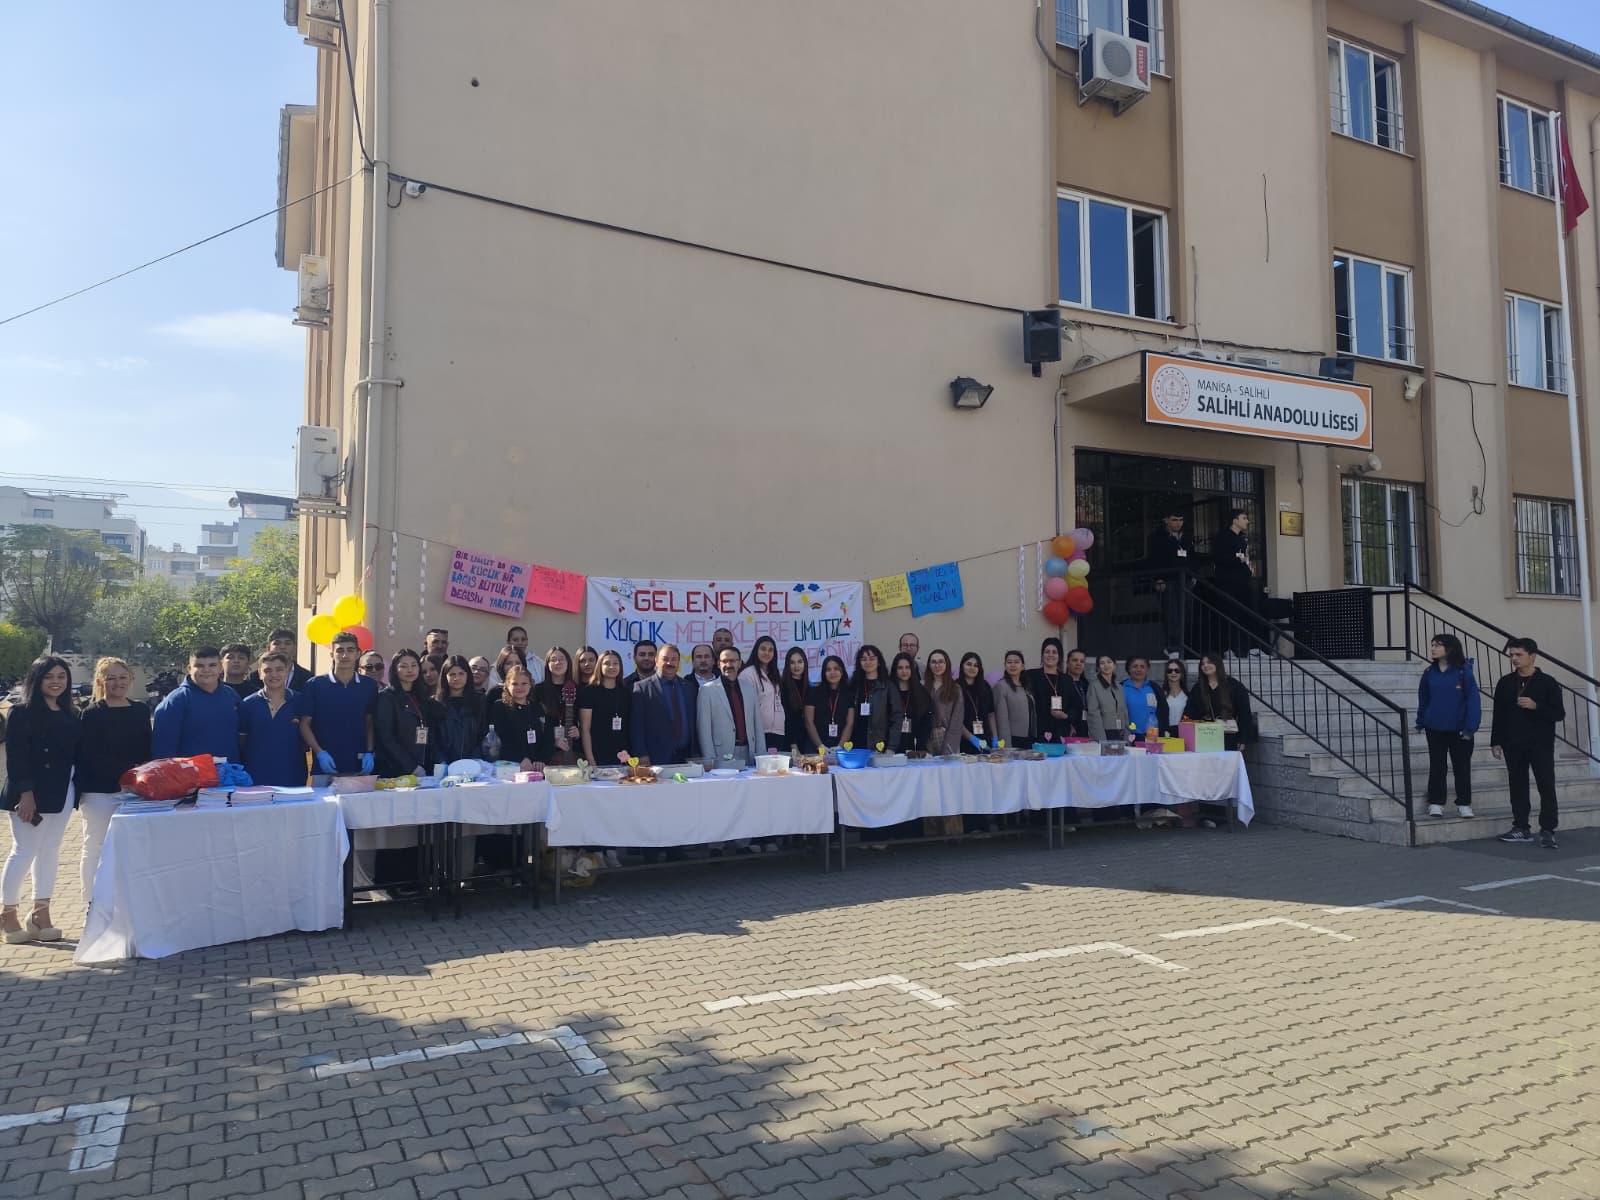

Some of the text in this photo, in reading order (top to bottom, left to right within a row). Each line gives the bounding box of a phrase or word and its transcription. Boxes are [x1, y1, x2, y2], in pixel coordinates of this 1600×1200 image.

[1197, 379, 1232, 394] MANİSA
[1239, 385, 1270, 400] SALİHLİ
[1197, 395, 1359, 433] SALİHLİ ANADOLU LİSESİ
[634, 589, 801, 614] GELENEKSEL
[605, 617, 667, 645] KÜÇÜK
